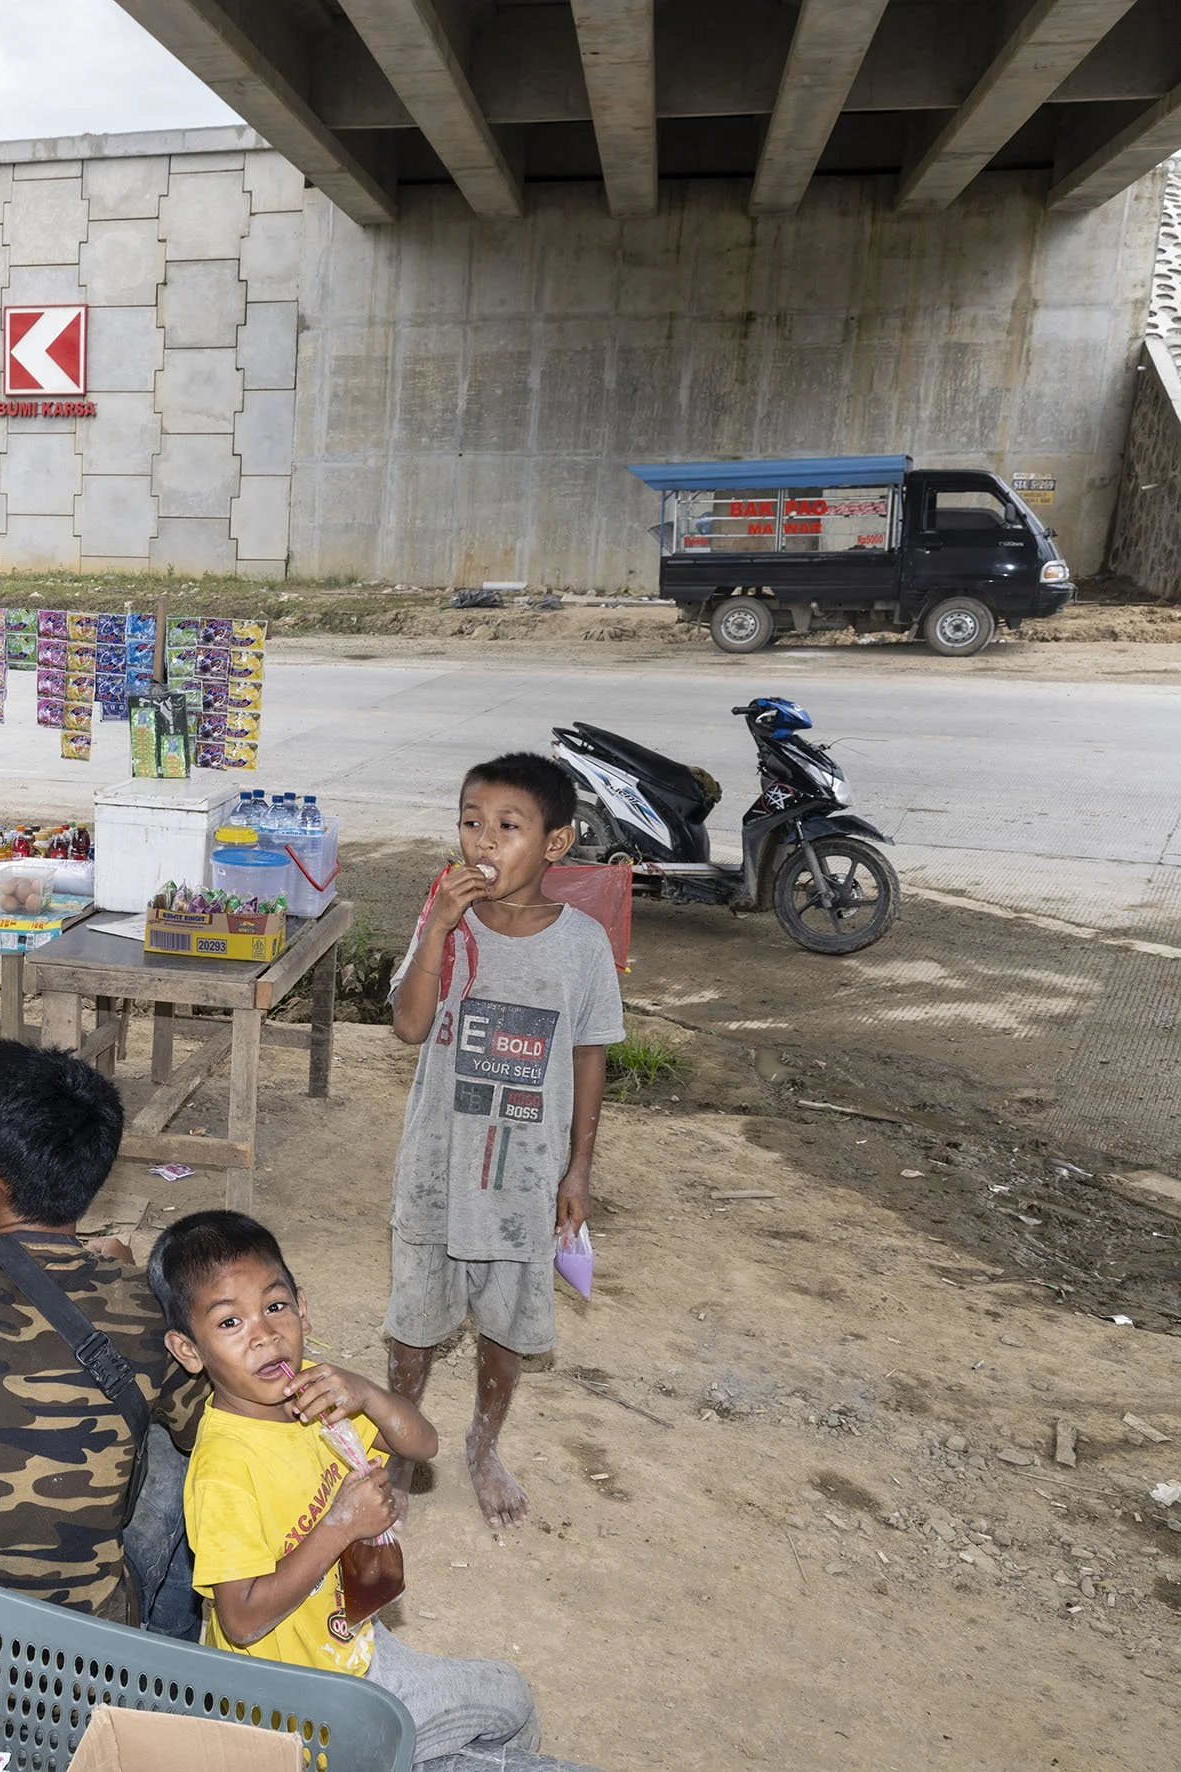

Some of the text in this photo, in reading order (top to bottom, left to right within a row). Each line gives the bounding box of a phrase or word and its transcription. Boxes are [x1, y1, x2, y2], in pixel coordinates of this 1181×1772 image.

[40, 402, 97, 418] KARSA
[730, 499, 828, 518] BAK PAO
[198, 940, 226, 952] 20293
[496, 1036, 542, 1057] BOLD
[473, 1059, 510, 1076] YOUR
[505, 1104, 539, 1120] BOSS
